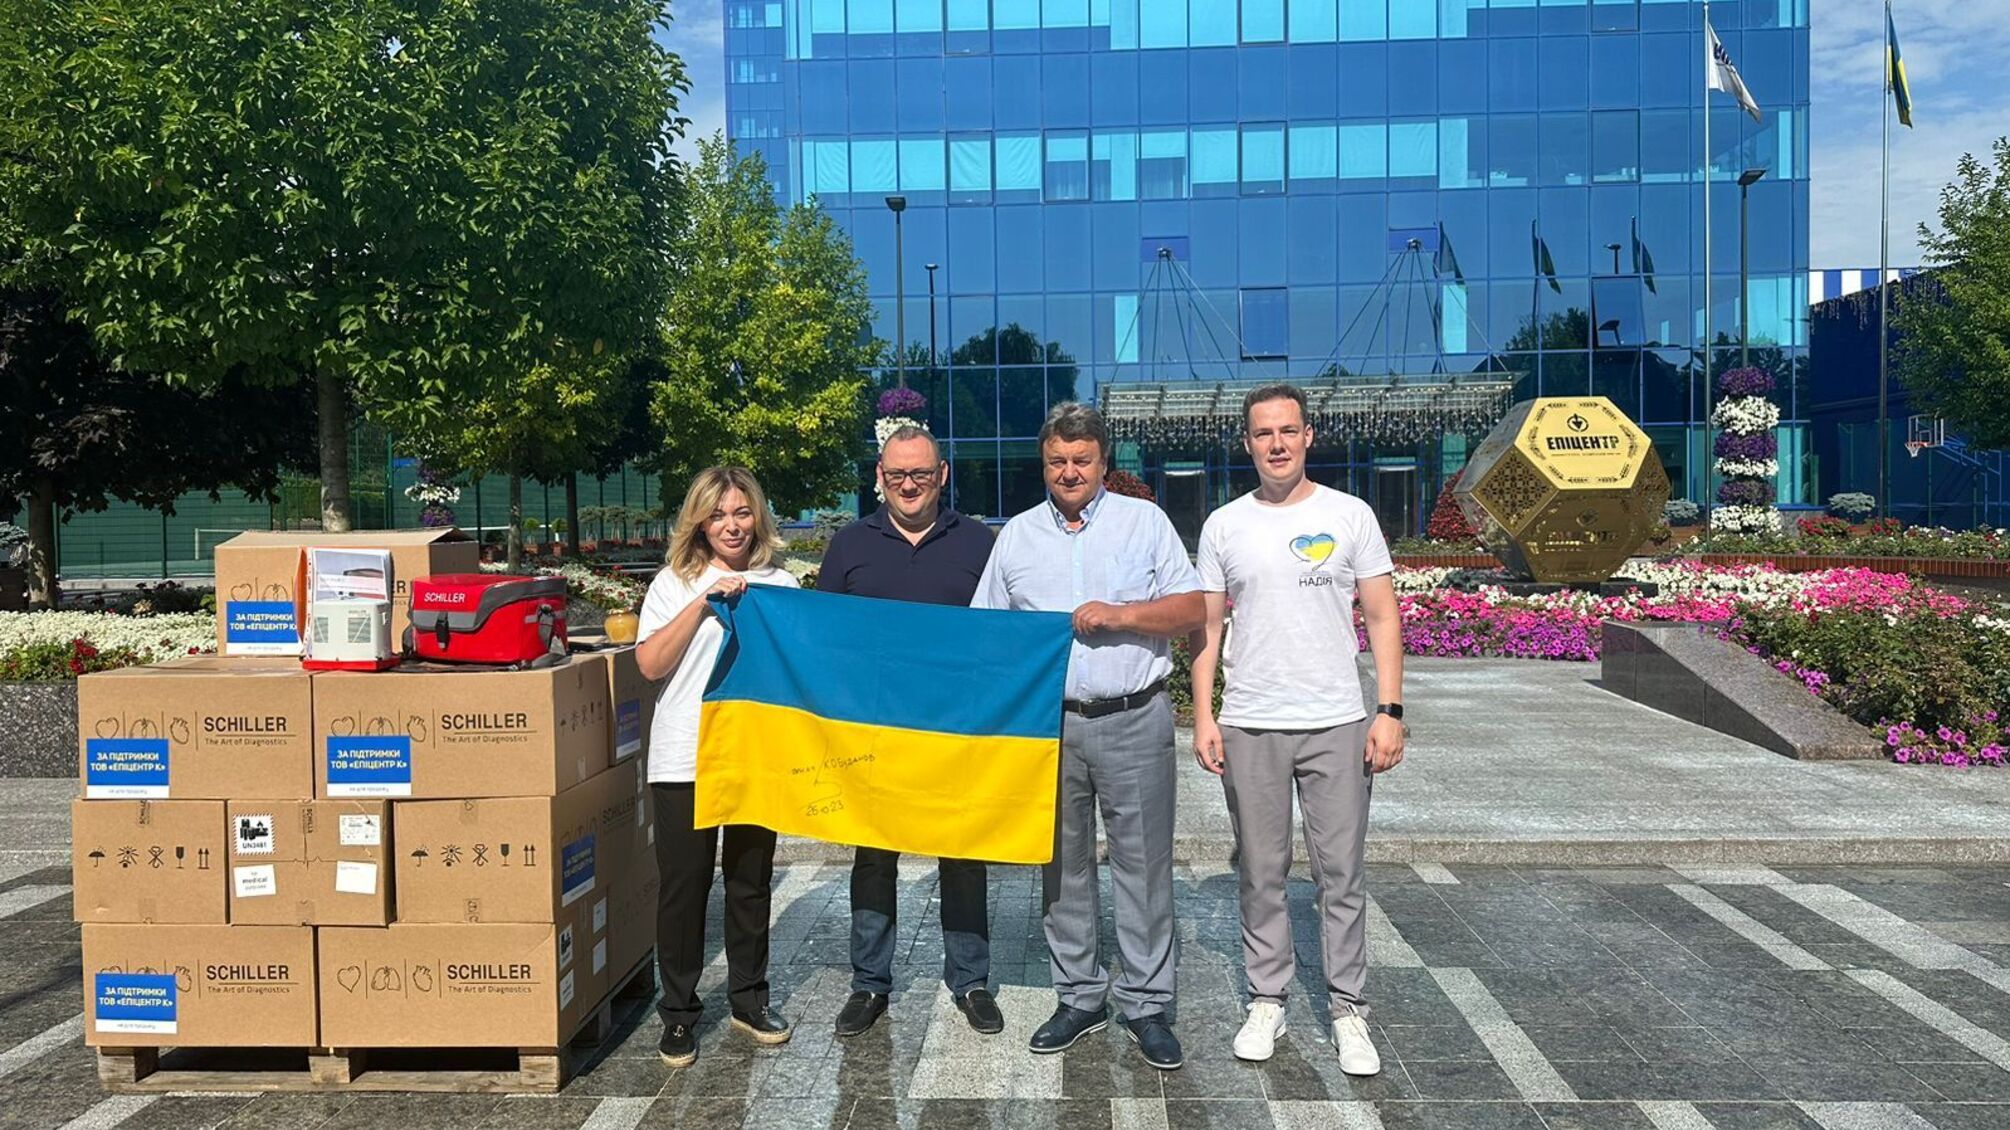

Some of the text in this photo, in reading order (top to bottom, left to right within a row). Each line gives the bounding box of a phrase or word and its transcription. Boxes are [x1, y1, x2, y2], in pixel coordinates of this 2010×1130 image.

[1546, 435, 1620, 450] ЕПІЦЕНТР
[1298, 576, 1333, 587] НАДІЯ
[424, 591, 466, 603] SCHILLER
[247, 613, 293, 622] ПІДТРИМКИ
[204, 716, 287, 732] SCHILLER
[441, 713, 528, 730] SCHILLER
[204, 738, 219, 746] The
[244, 738, 288, 747] Diagnostics
[442, 735, 528, 745] The Art of Diagnostics
[96, 752, 159, 762] ЗА ПІДТРИМКИ
[337, 749, 401, 760] ЗА ПІДТРИМКИ
[90, 763, 108, 771] ТОВ
[108, 763, 154, 772] «ЕПІЦЕНТР
[331, 761, 348, 769] ТОВ
[349, 761, 396, 770] «ЕПІЦЕНТР
[242, 876, 268, 884] medical
[206, 965, 289, 980] SCHILLER
[447, 964, 531, 980] SCHILLER
[105, 987, 167, 997] ЗА ПІДТРИМКИ
[247, 986, 290, 995] Diagnostics
[448, 985, 532, 994] The Art of Diagnostics
[99, 997, 116, 1005] ТОВ
[117, 998, 162, 1007] «ЕПІЦЕНТР
